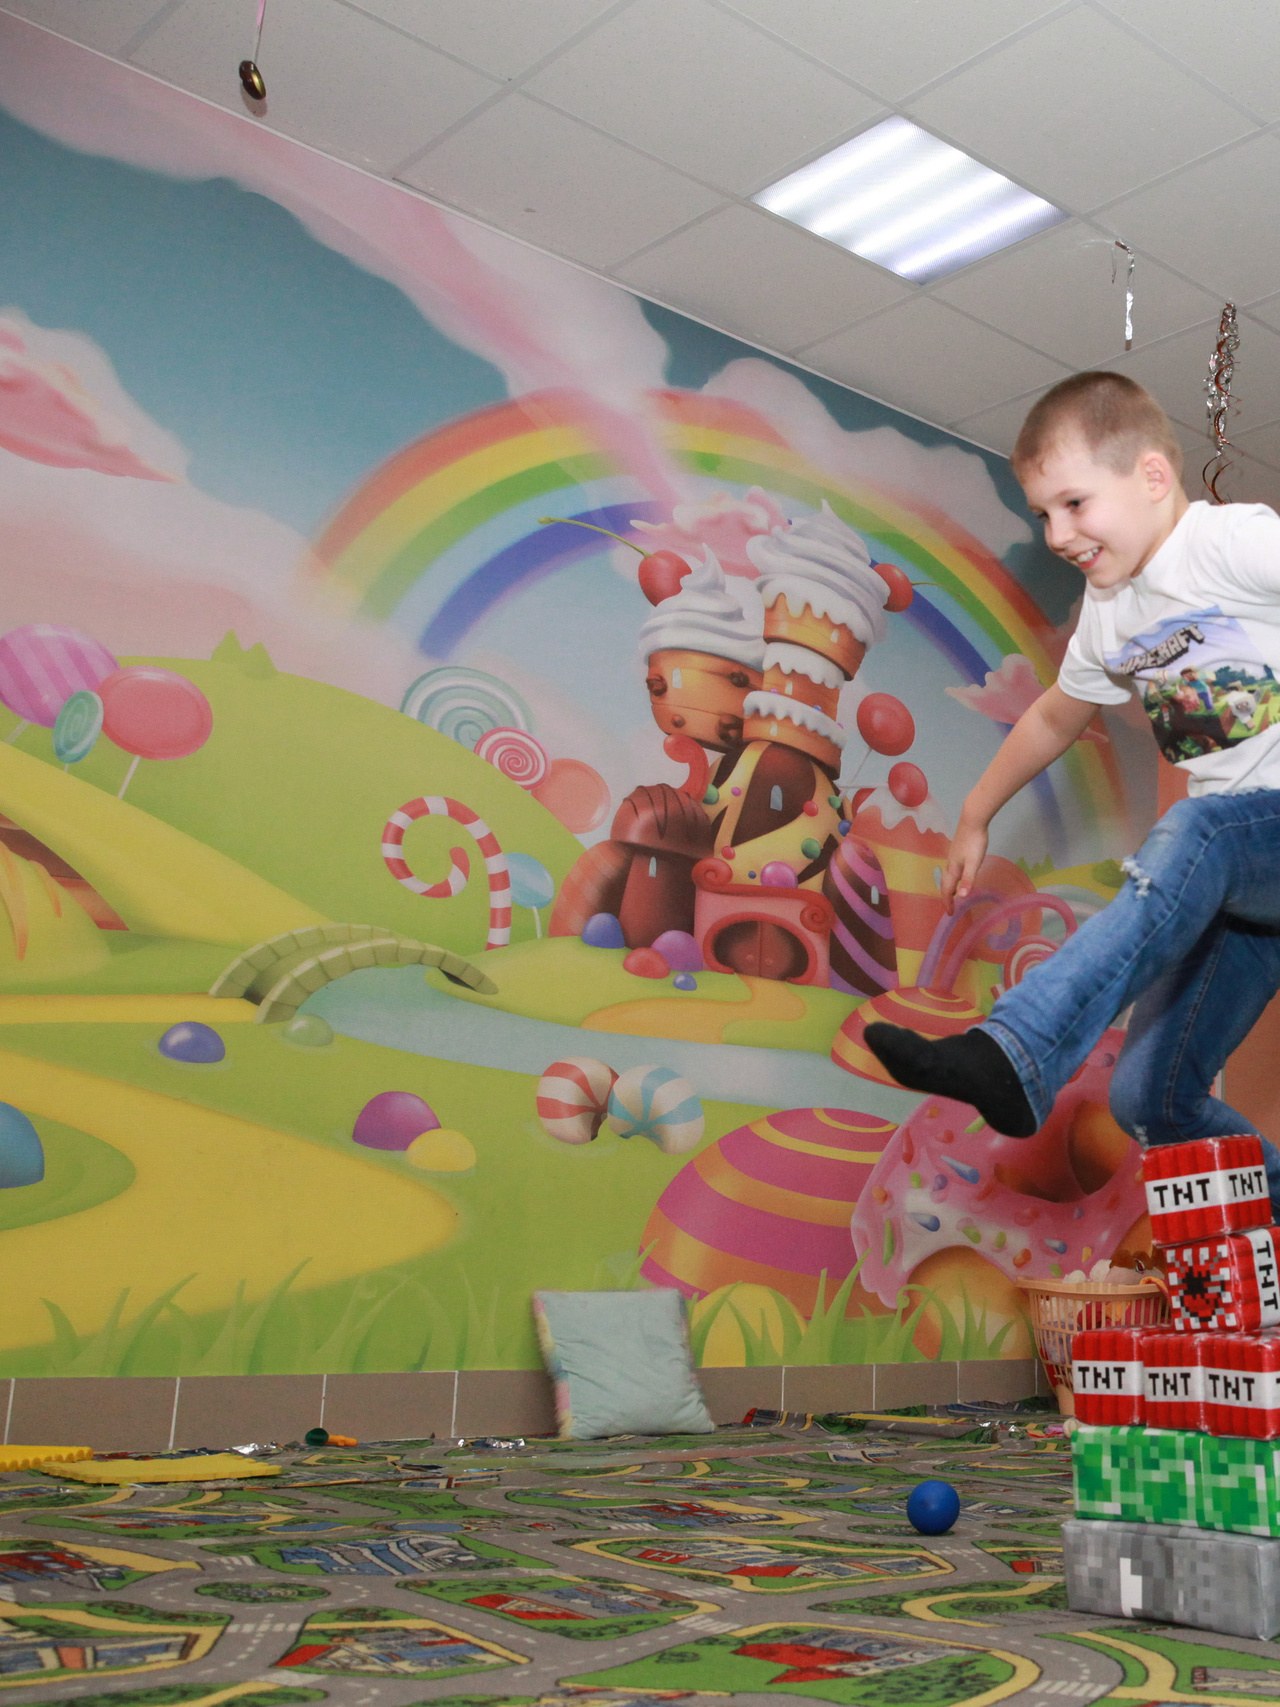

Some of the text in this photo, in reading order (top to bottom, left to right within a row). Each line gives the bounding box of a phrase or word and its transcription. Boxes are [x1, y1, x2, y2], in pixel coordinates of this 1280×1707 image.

[1117, 622, 1205, 675] MINECRAFT
[1153, 1178, 1210, 1208] TNT
[1229, 1171, 1262, 1197] TNT
[1257, 1241, 1278, 1310] TNT
[1078, 1366, 1125, 1389] TNT
[1149, 1373, 1191, 1396] TNT
[1209, 1374, 1255, 1401] TNT
